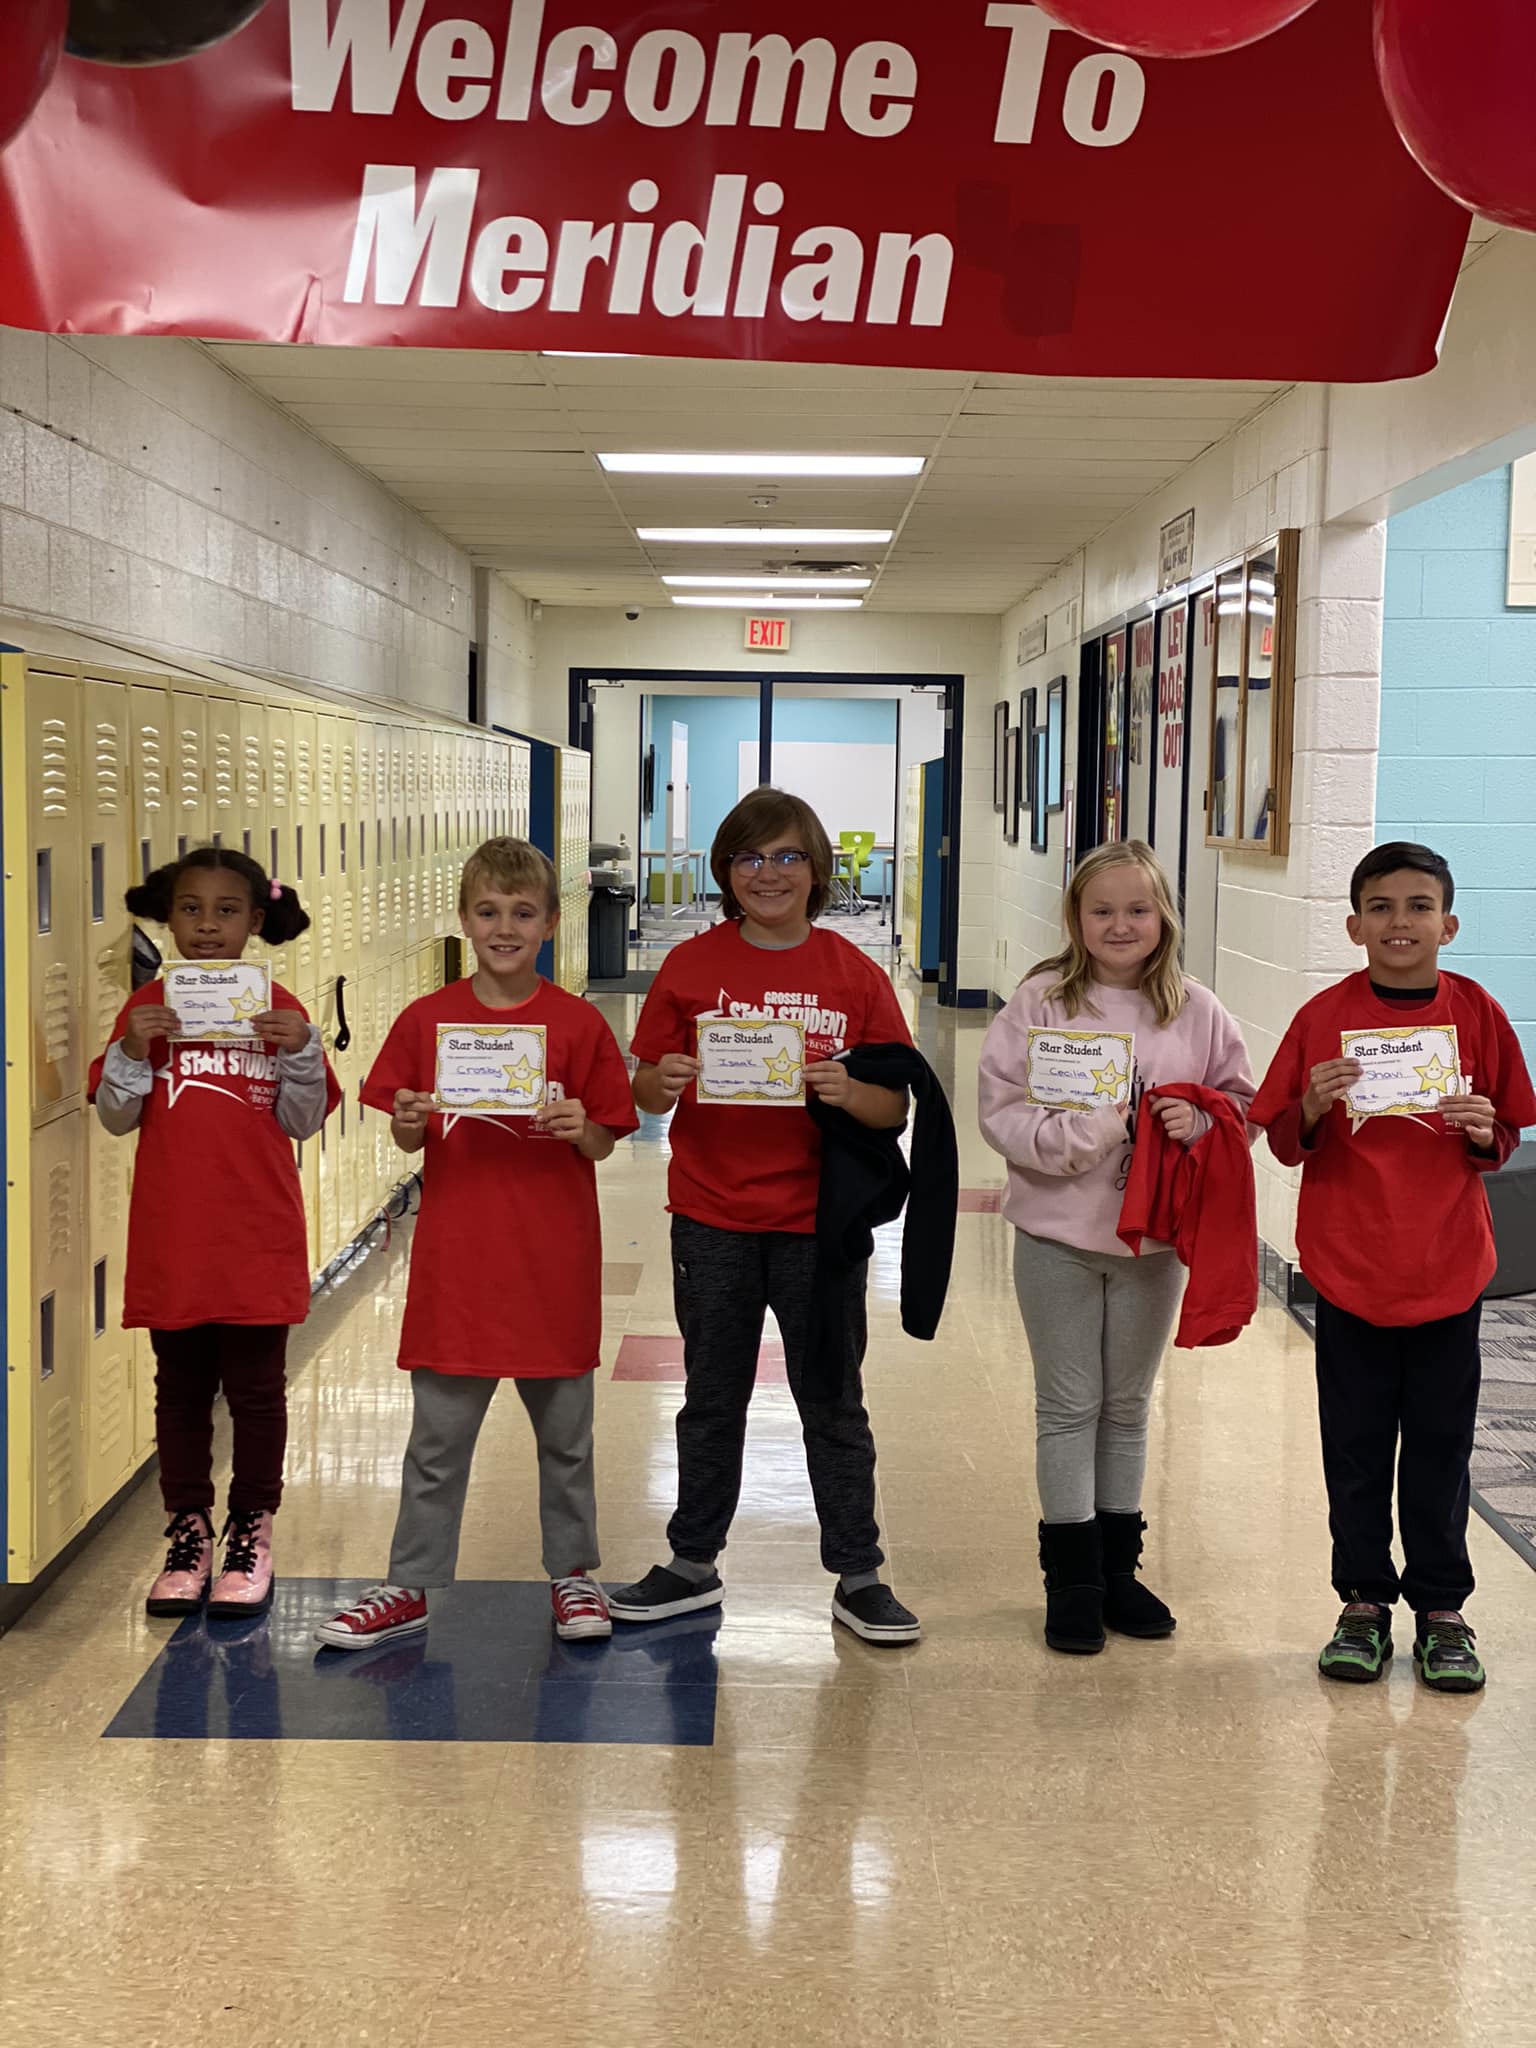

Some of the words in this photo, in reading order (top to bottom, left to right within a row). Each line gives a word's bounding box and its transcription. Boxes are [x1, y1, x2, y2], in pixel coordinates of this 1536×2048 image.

[289, 0, 918, 138] Welcome
[983, 1, 1147, 148] To
[342, 163, 955, 327] Meridian
[750, 620, 785, 647] EXIT
[1167, 608, 1185, 659] LET
[1163, 723, 1184, 769] OUT
[174, 974, 197, 986] Star
[199, 972, 239, 985] Student
[764, 991, 802, 1005] GROSSE
[804, 993, 819, 1007] ILE
[448, 1039, 473, 1051] Star
[474, 1039, 515, 1051] Student
[708, 1032, 734, 1045] Star
[734, 1032, 774, 1045] Student
[1039, 1041, 1063, 1055] Star
[1063, 1043, 1104, 1057] Student
[1354, 1045, 1379, 1058] Star
[1380, 1040, 1424, 1055] Student
[179, 1049, 227, 1077] STAR
[1049, 1067, 1089, 1080] Cecilia
